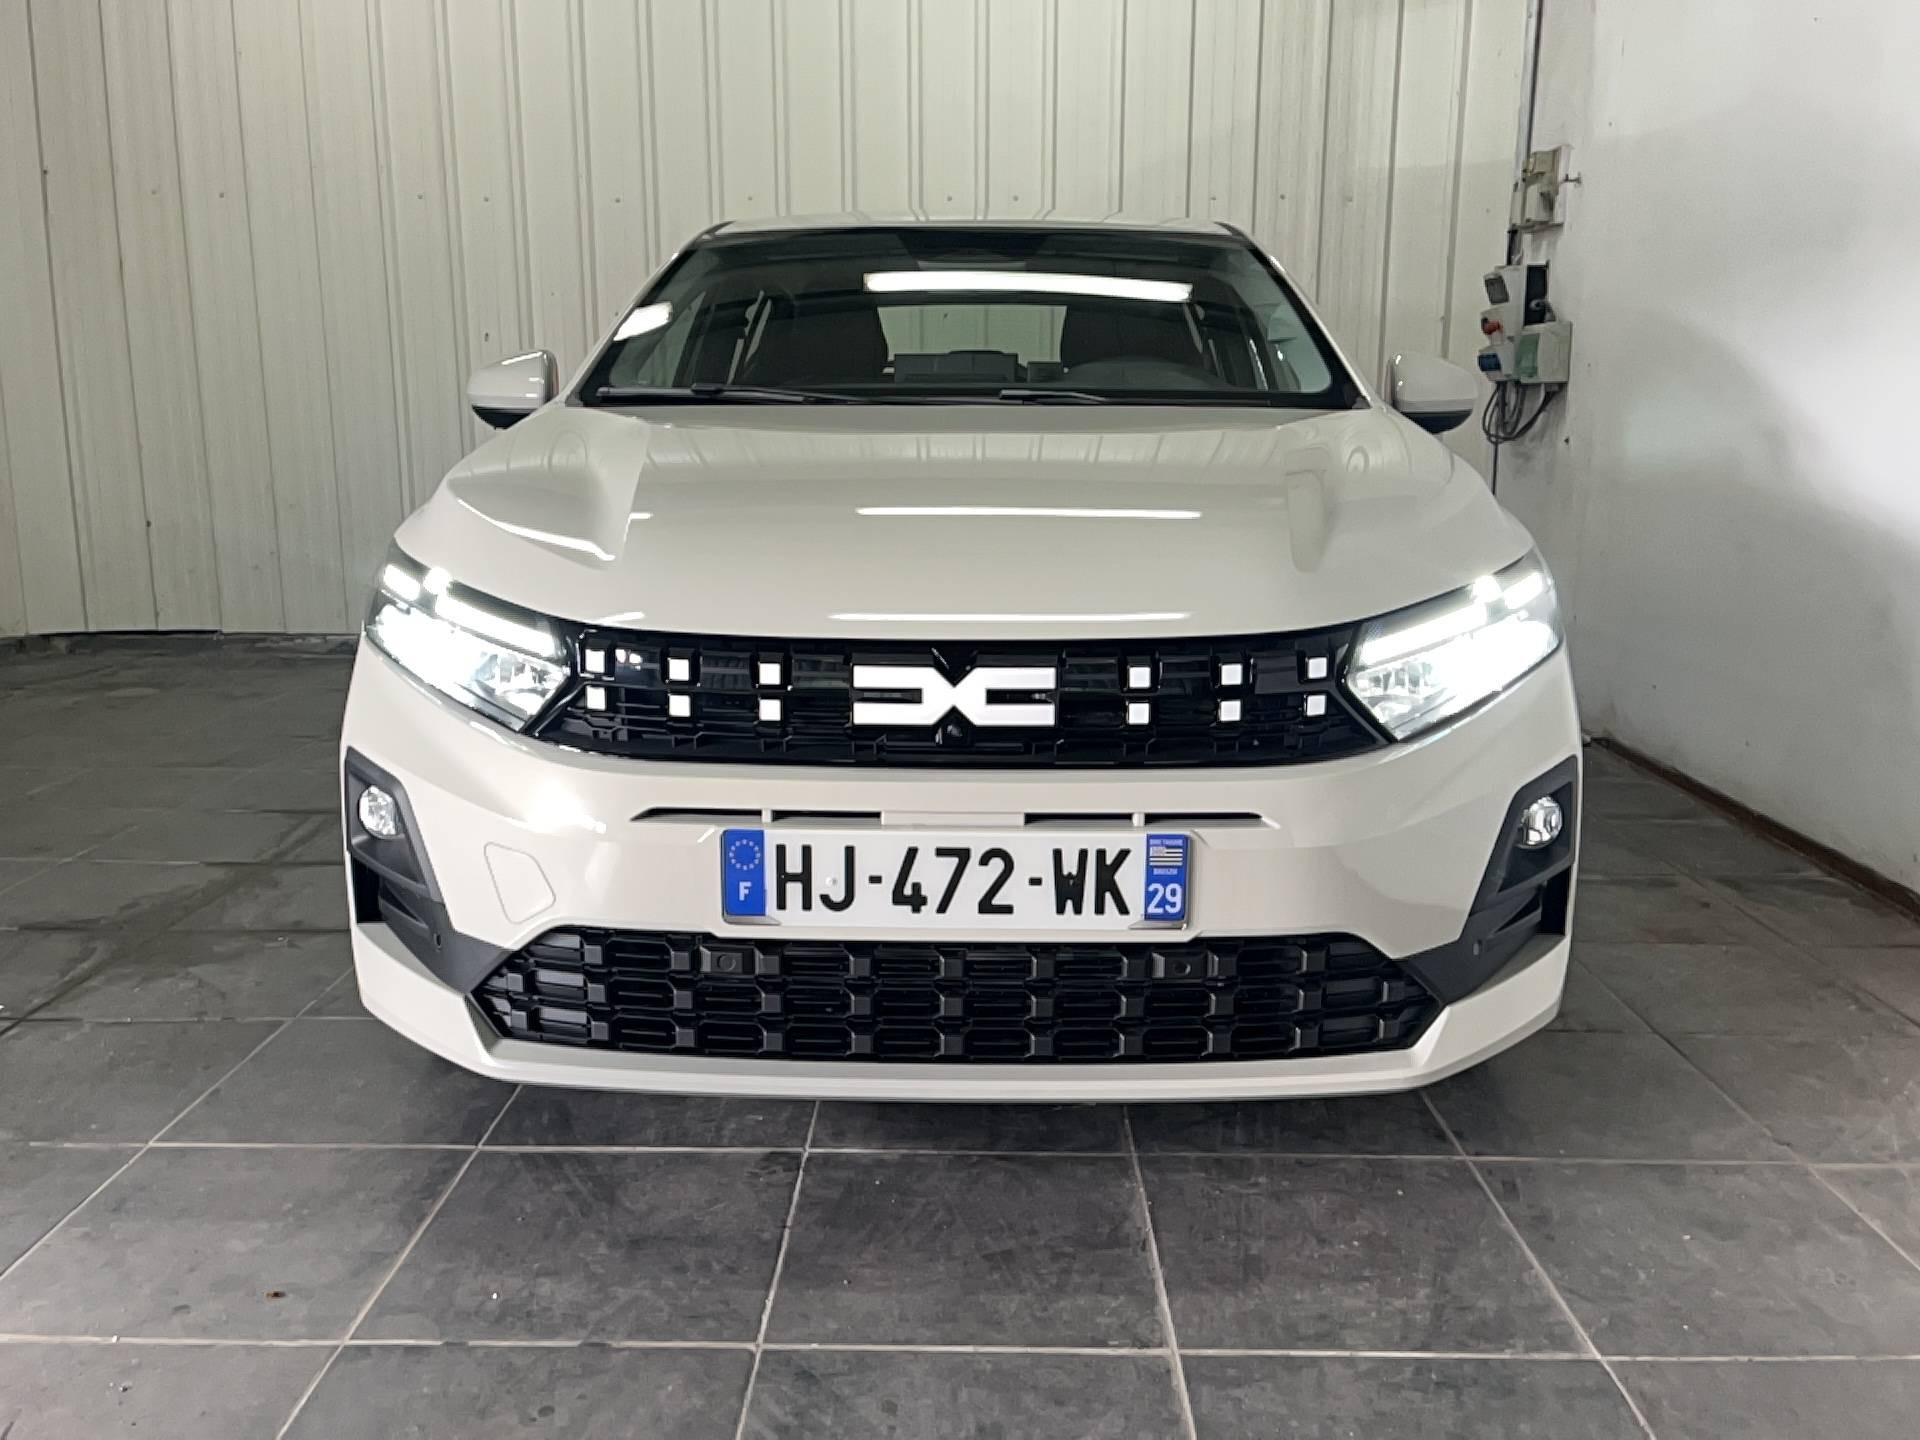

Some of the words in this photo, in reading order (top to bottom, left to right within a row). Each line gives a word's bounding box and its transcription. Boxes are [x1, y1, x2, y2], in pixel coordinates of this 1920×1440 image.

[739, 881, 752, 901] F
[776, 844, 1131, 915] HJ-472-WK
[1147, 882, 1182, 914] 29
